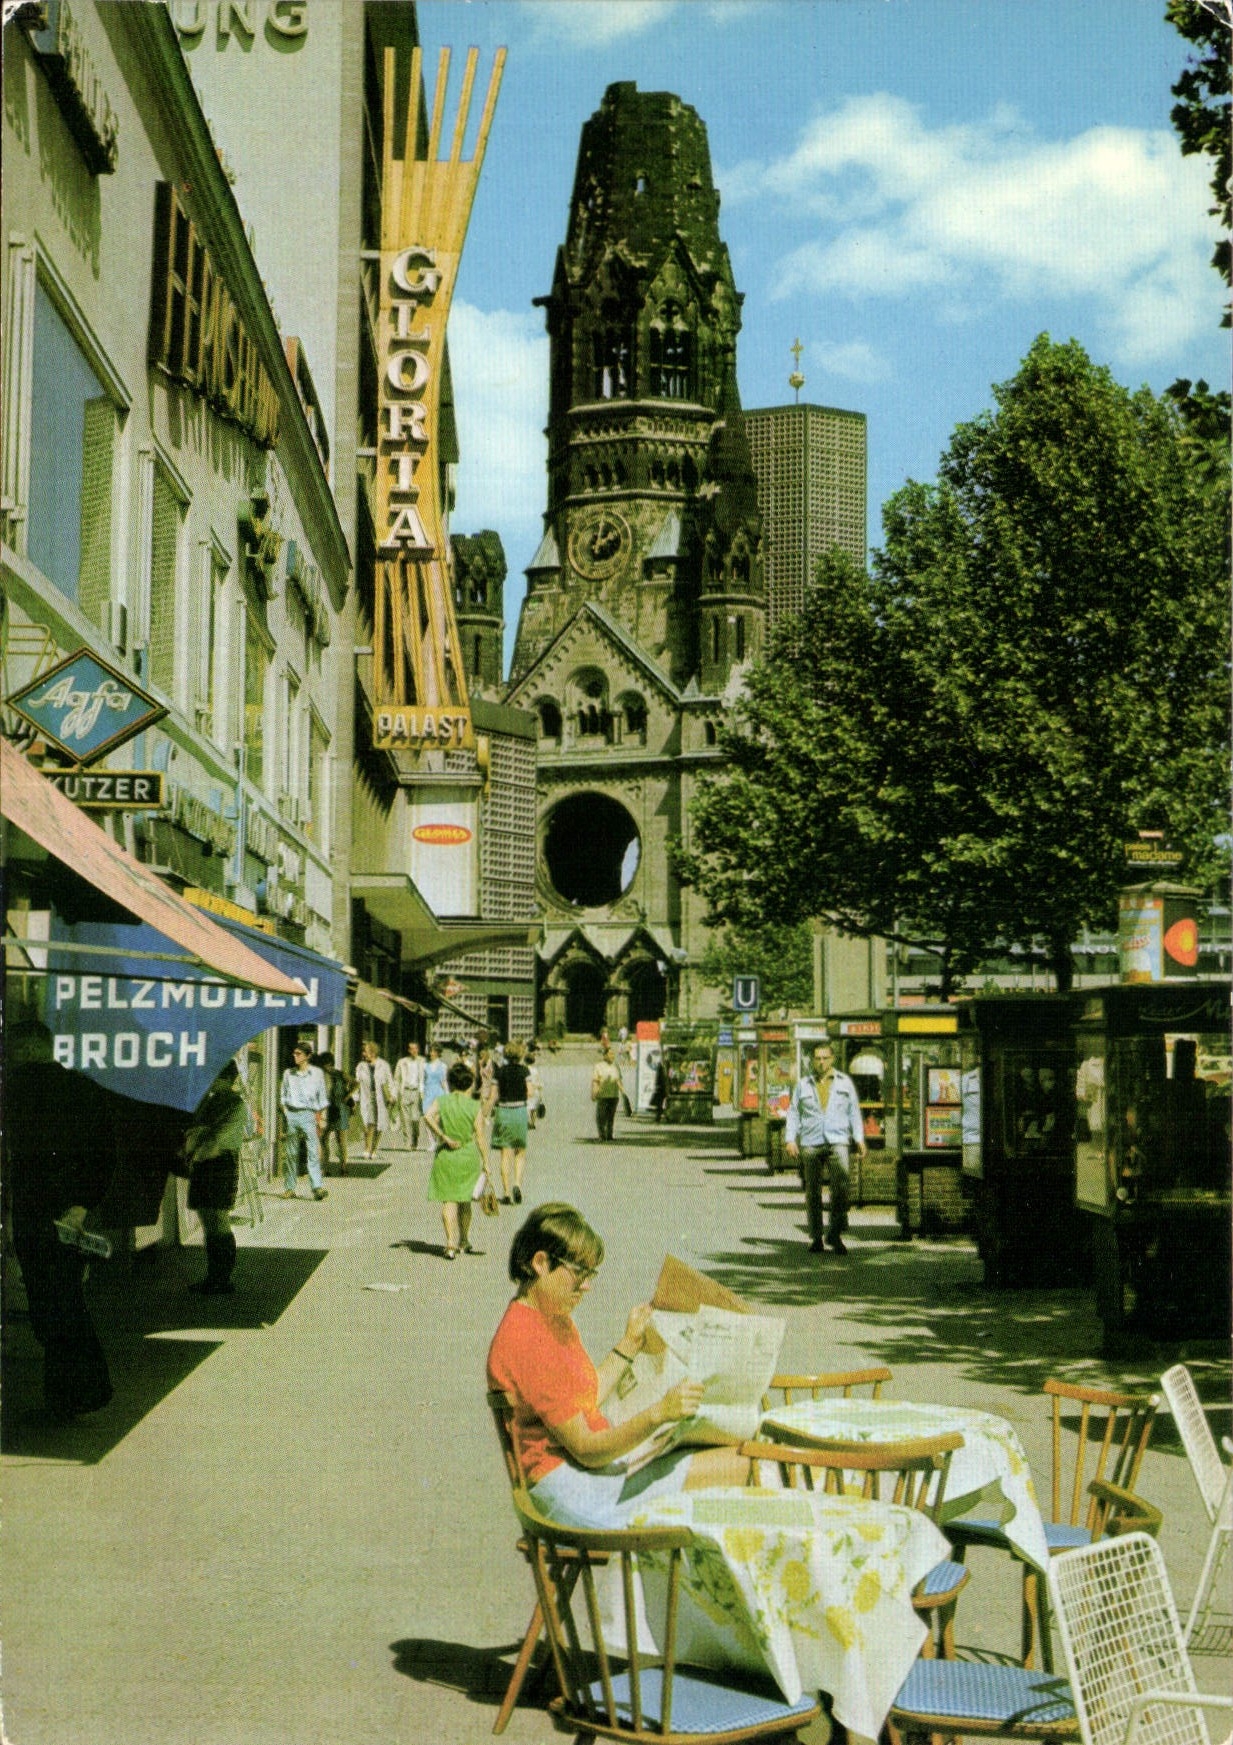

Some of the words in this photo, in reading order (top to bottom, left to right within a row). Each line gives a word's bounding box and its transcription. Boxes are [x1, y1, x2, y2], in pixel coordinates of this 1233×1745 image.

[378, 247, 442, 549] GLORIA
[27, 675, 132, 739] Agfa
[378, 713, 468, 738] PALAST
[737, 980, 755, 1007] U
[53, 1031, 207, 1069] BROCH
